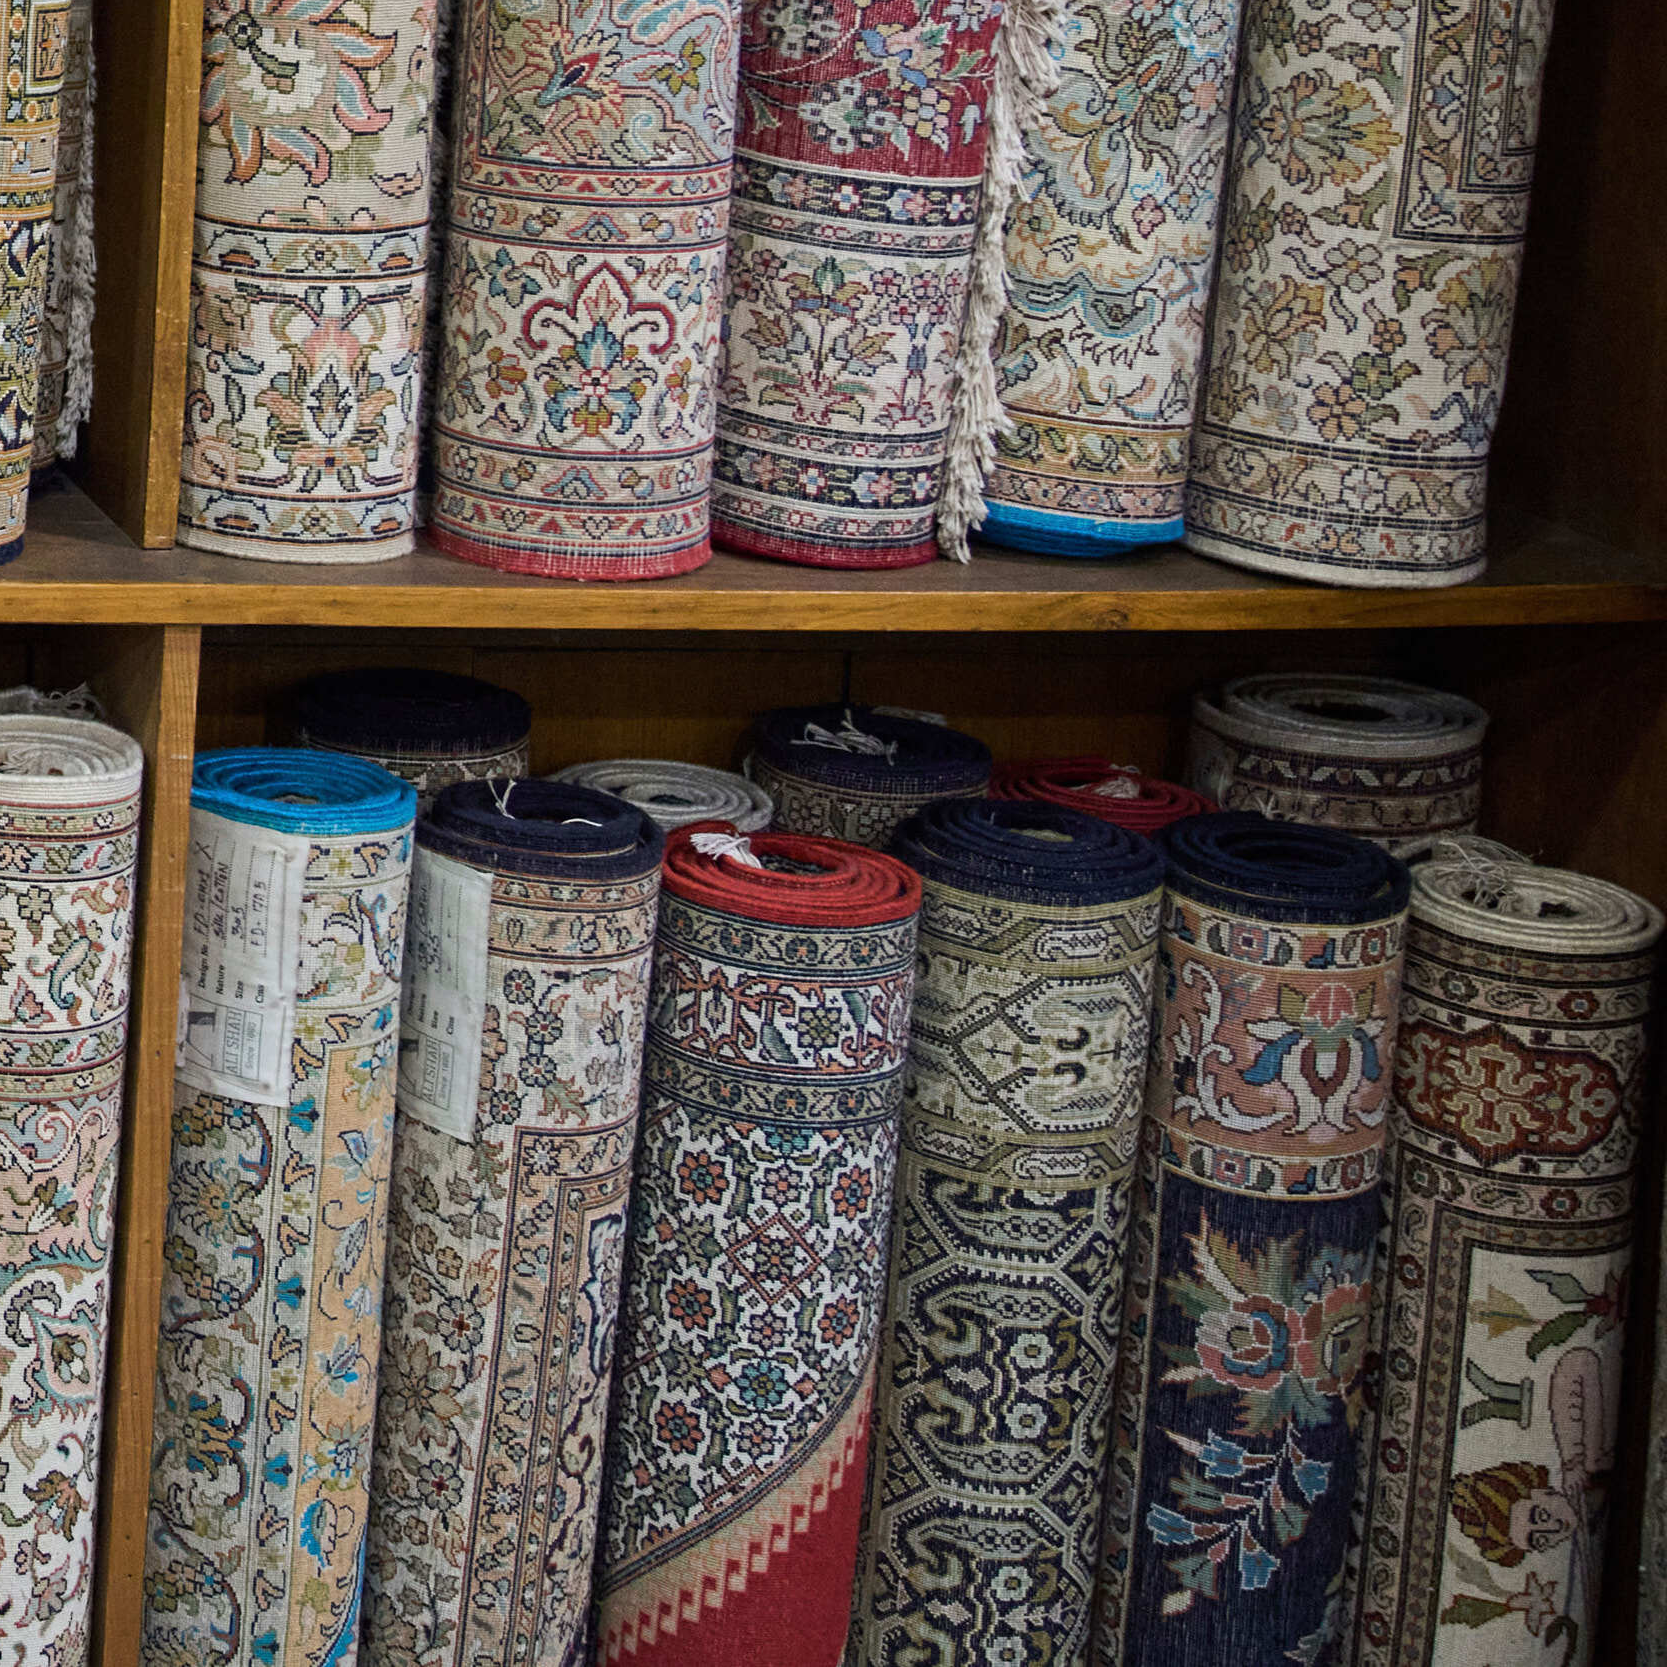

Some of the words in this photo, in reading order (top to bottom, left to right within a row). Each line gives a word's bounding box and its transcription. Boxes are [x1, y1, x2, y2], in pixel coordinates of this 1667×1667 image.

[198, 958, 209, 989] Design
[215, 964, 225, 995] Nature
[234, 980, 244, 999] Size
[226, 1011, 242, 1049] SHAH
